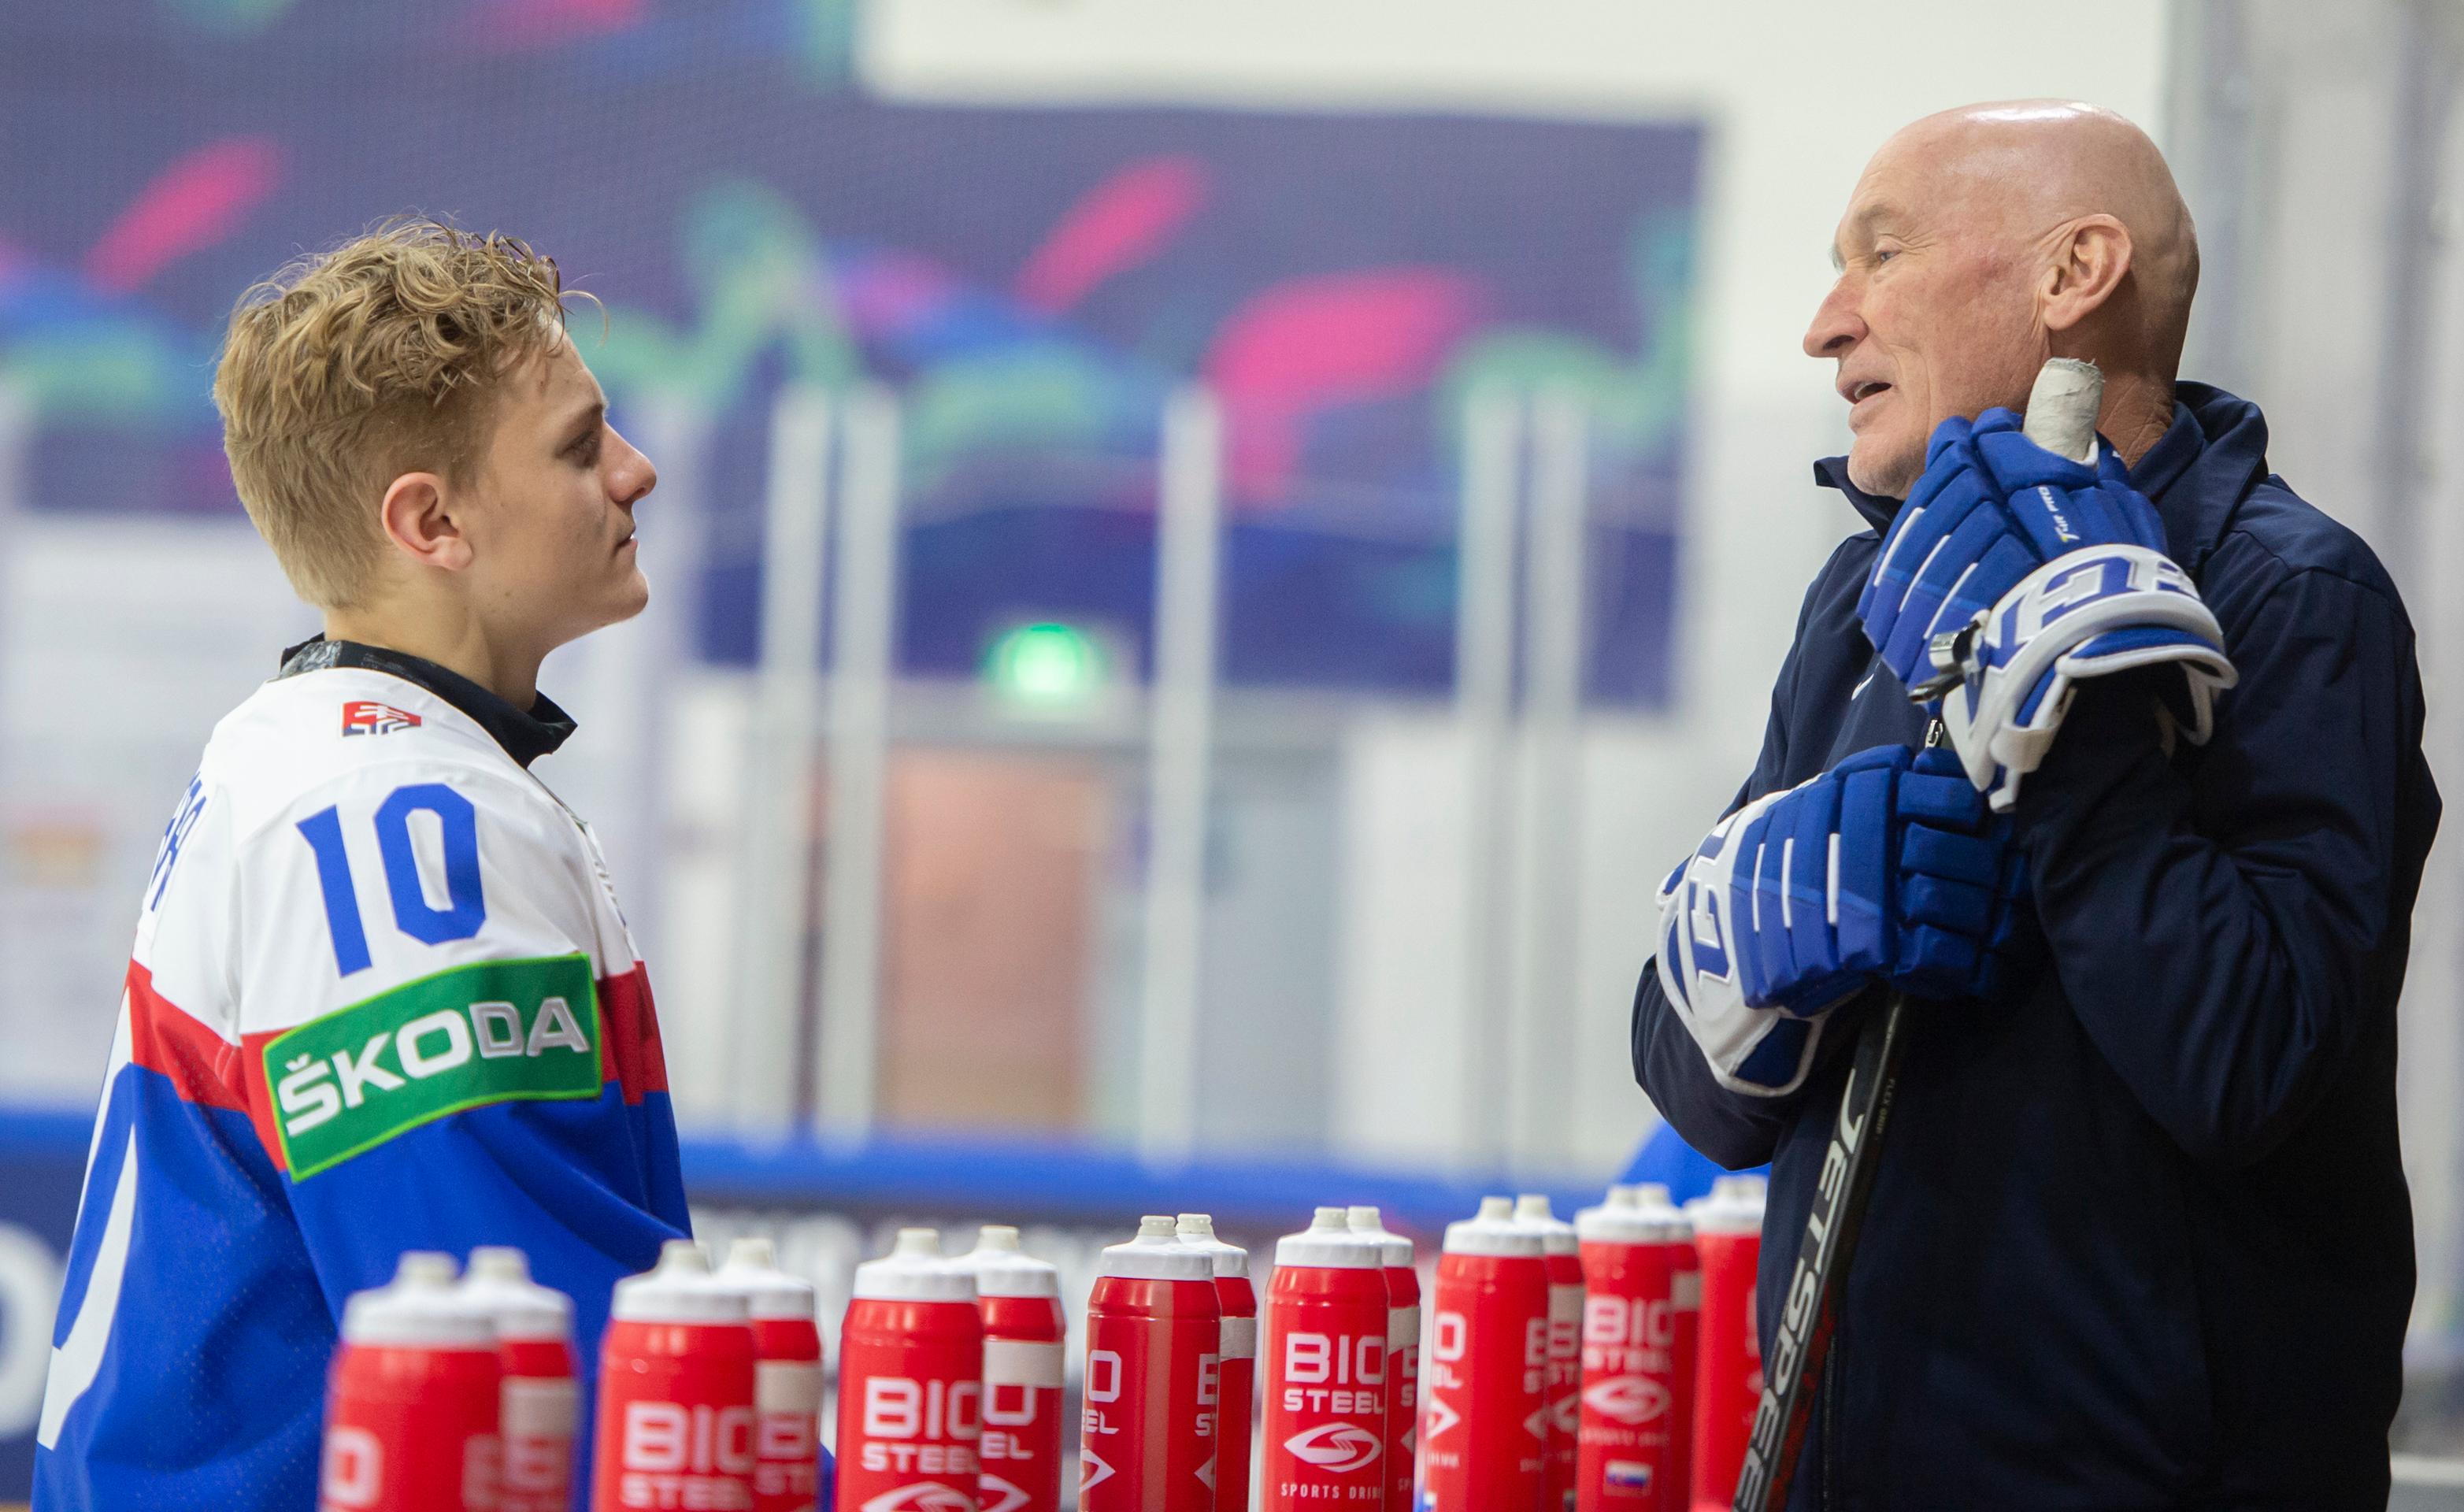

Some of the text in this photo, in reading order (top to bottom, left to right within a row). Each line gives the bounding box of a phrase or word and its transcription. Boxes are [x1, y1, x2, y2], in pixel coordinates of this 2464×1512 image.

[295, 783, 487, 978] 10
[277, 997, 592, 1137] ŠKODA
[1731, 1068, 1865, 1512] JETSPEE
[1285, 1332, 1386, 1384] BIO
[863, 1377, 983, 1440] BIO
[1284, 1388, 1384, 1415] STEEL
[861, 1442, 982, 1474] STEE
[1280, 1482, 1339, 1499] SPORTS
